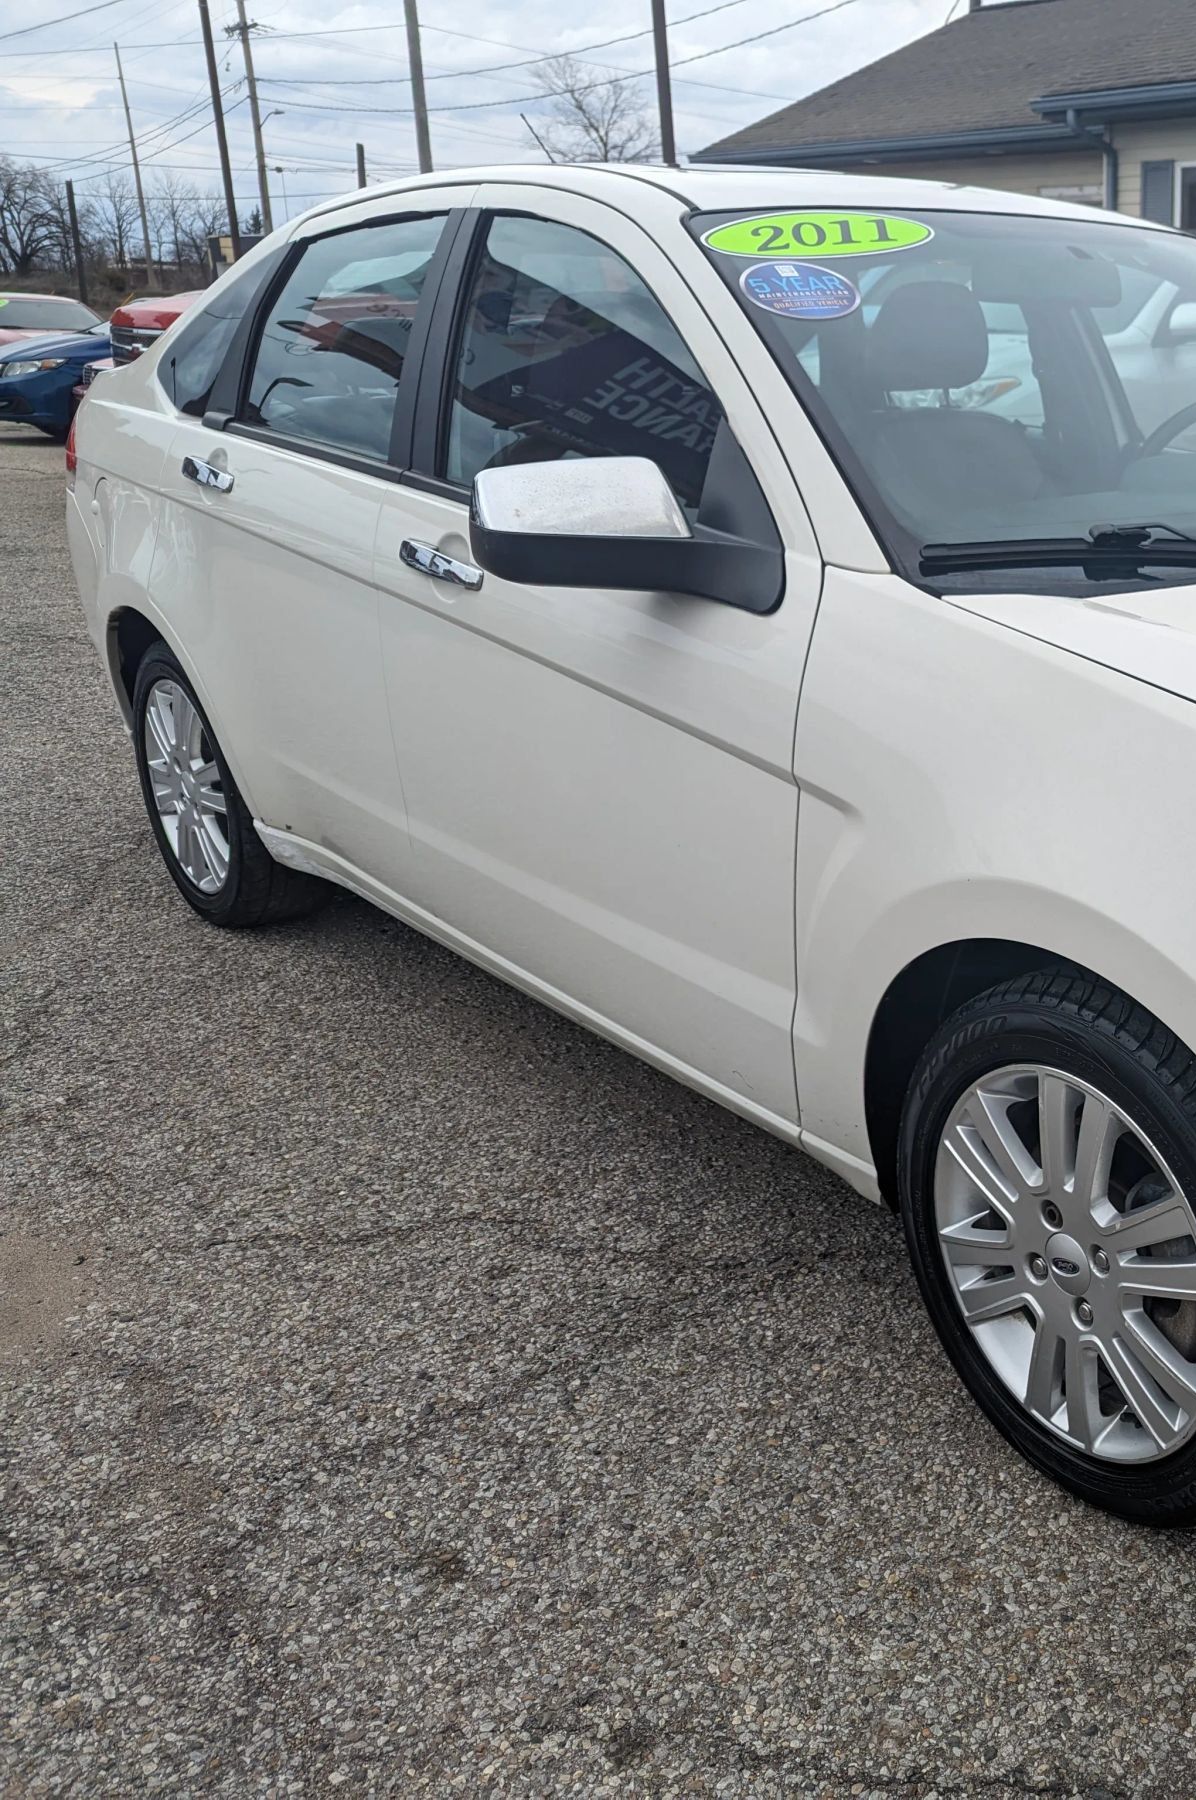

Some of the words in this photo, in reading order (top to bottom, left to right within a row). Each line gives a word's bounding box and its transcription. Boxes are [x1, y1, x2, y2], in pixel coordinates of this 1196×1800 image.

[750, 218, 898, 252] 2011
[748, 278, 771, 294] 5
[771, 275, 845, 292] YEAR
[758, 290, 822, 299] MAINTENANCE
[773, 301, 815, 310] QUALIFIED
